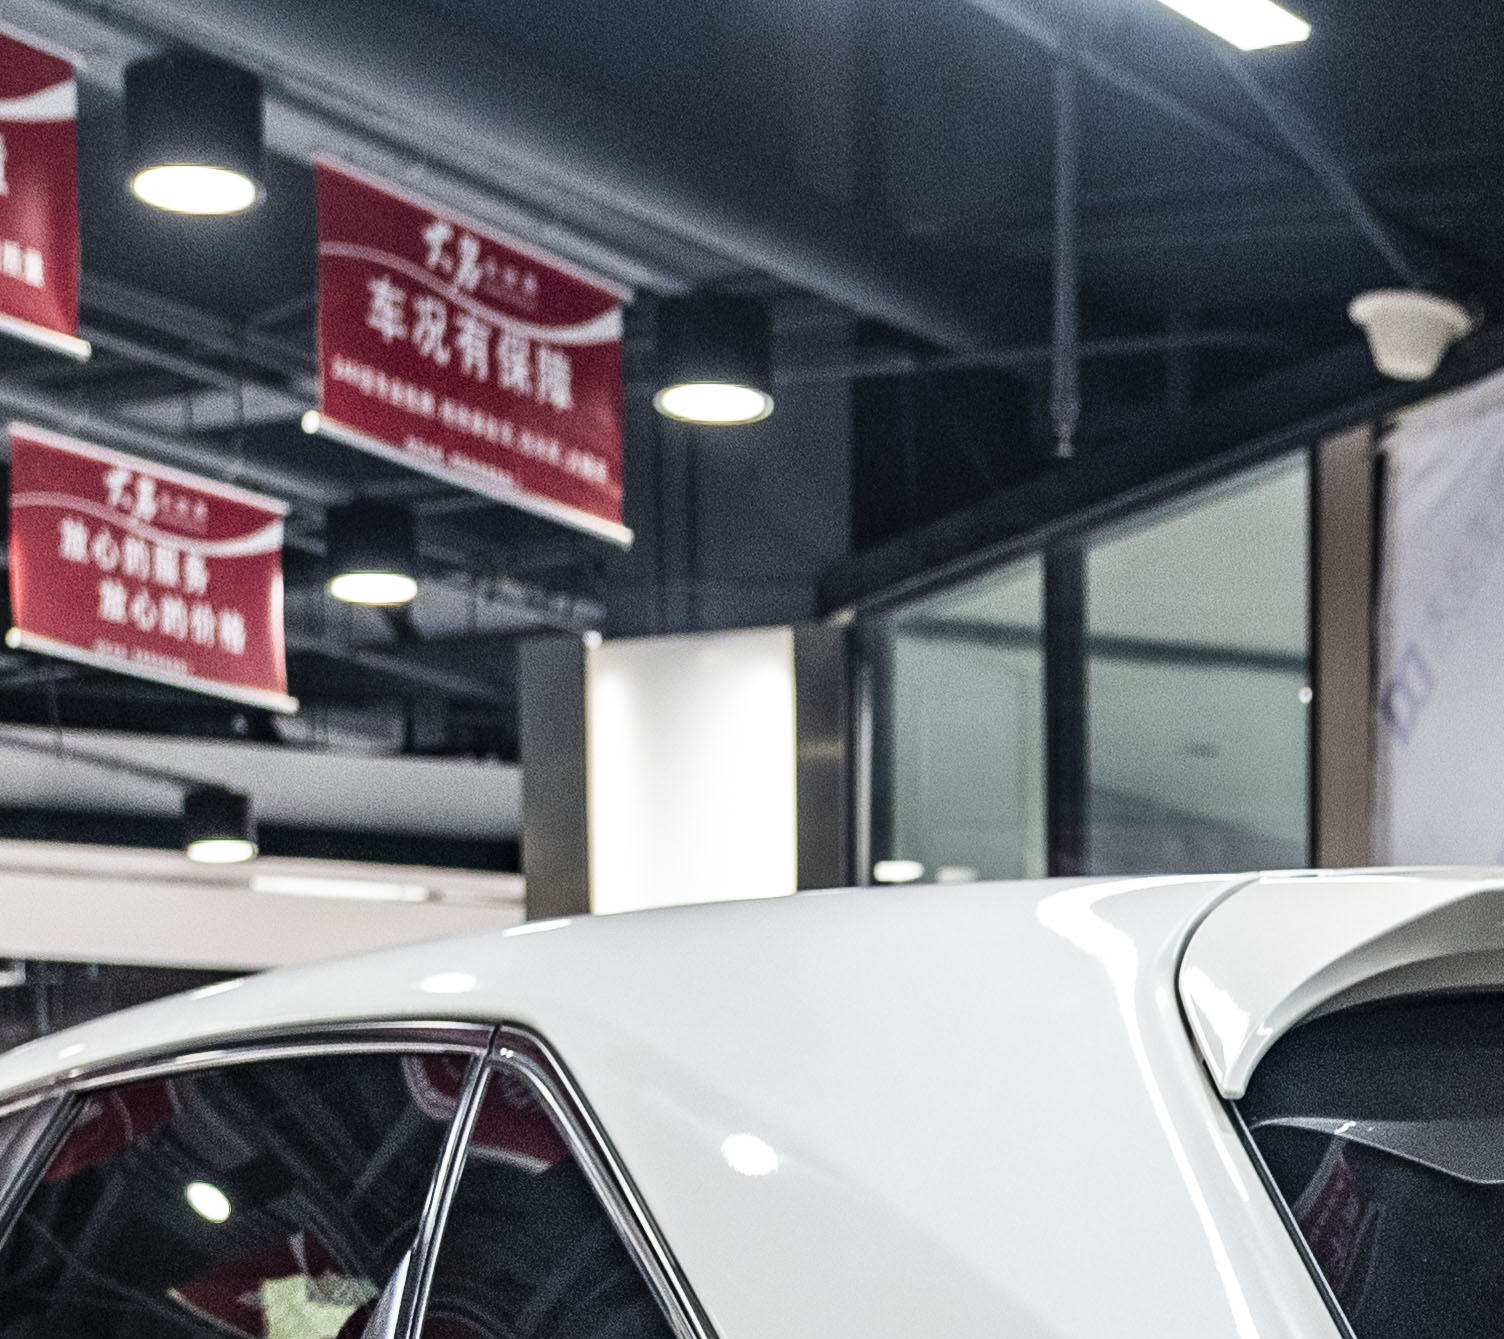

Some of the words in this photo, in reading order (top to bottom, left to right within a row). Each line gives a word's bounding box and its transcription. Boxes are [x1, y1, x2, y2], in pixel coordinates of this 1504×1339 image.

[365, 276, 573, 413] 车况有保障
